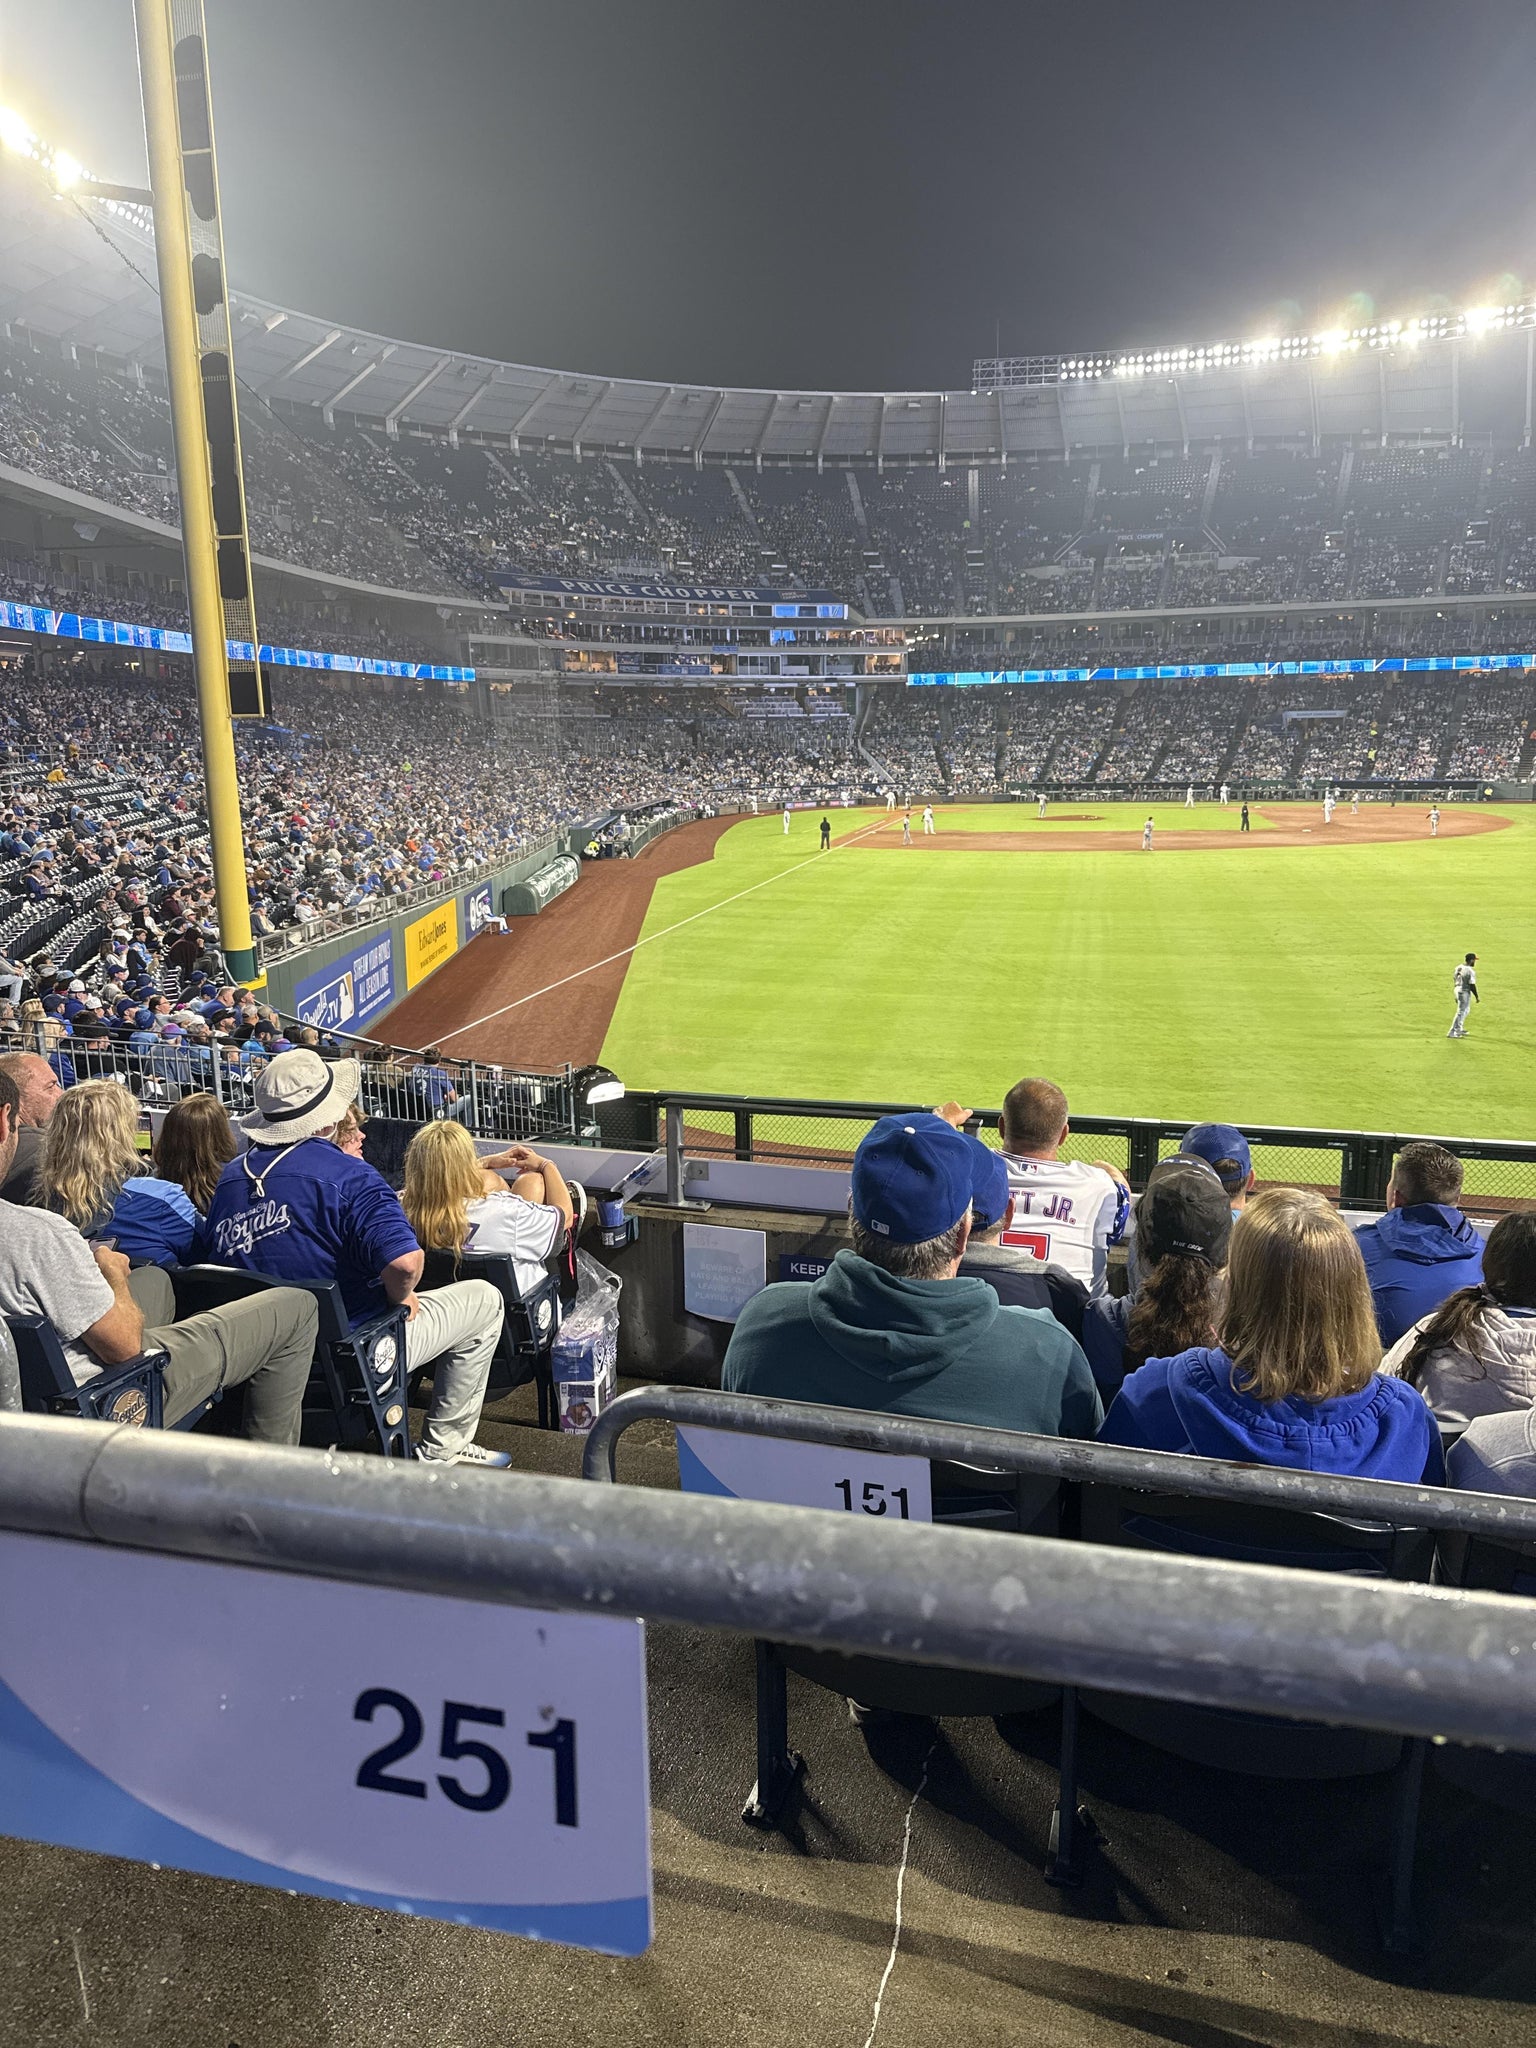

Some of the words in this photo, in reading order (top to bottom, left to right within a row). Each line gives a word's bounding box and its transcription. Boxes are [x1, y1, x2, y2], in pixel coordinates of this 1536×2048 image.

[560, 580, 636, 595] PRICE
[640, 586, 759, 600] CHOPPER
[1043, 1194, 1077, 1225] JR.
[216, 1200, 291, 1255] Royals
[1187, 1243, 1205, 1252] CREW
[699, 1261, 733, 1274] BEWARE
[790, 1262, 826, 1276] KEEP
[690, 1271, 711, 1281] BATS
[712, 1275, 729, 1283] AND
[697, 1283, 732, 1293] LEAVING
[694, 1291, 729, 1302] PLAYING
[834, 1478, 909, 1520] 151
[353, 1687, 579, 1828] 251
